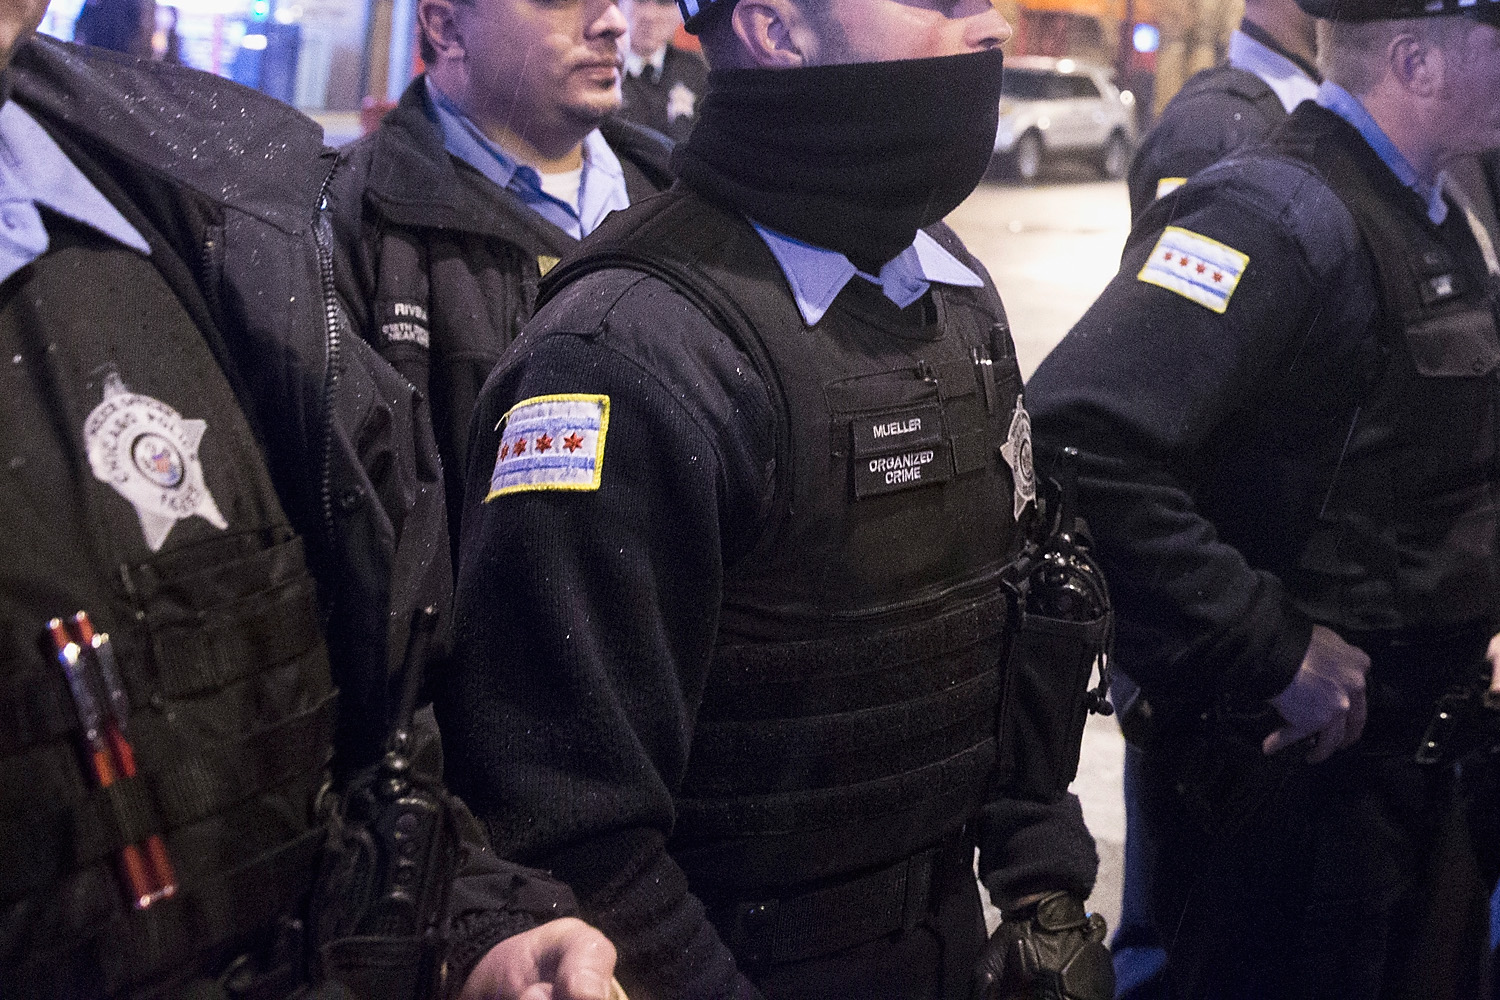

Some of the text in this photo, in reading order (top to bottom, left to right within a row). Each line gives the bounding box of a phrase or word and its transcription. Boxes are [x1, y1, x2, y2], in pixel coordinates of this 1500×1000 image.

[873, 418, 921, 438] MUELLER
[869, 450, 934, 473] ORGANIZED
[885, 466, 921, 485] CRIME
